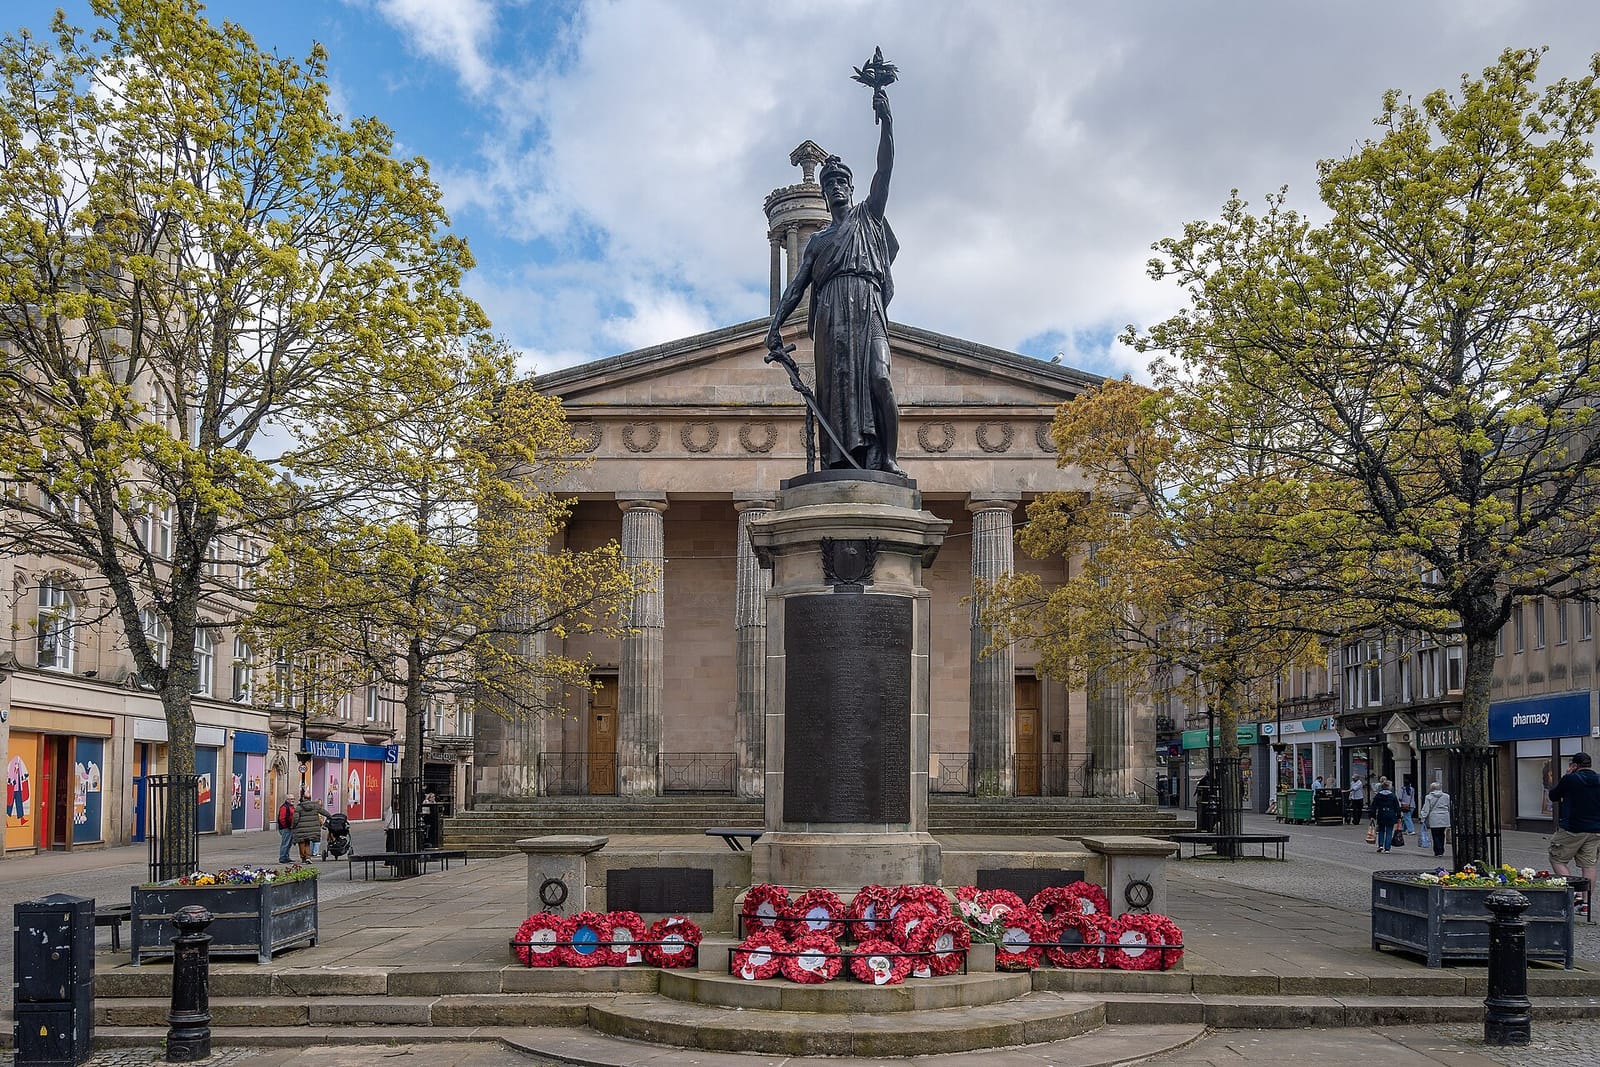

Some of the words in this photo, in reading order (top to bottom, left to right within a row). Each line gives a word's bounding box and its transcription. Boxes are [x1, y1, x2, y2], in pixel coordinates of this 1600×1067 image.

[1512, 712, 1550, 727] pharmacy
[1420, 731, 1446, 747] PANCAKE
[310, 741, 340, 757] WHSmith
